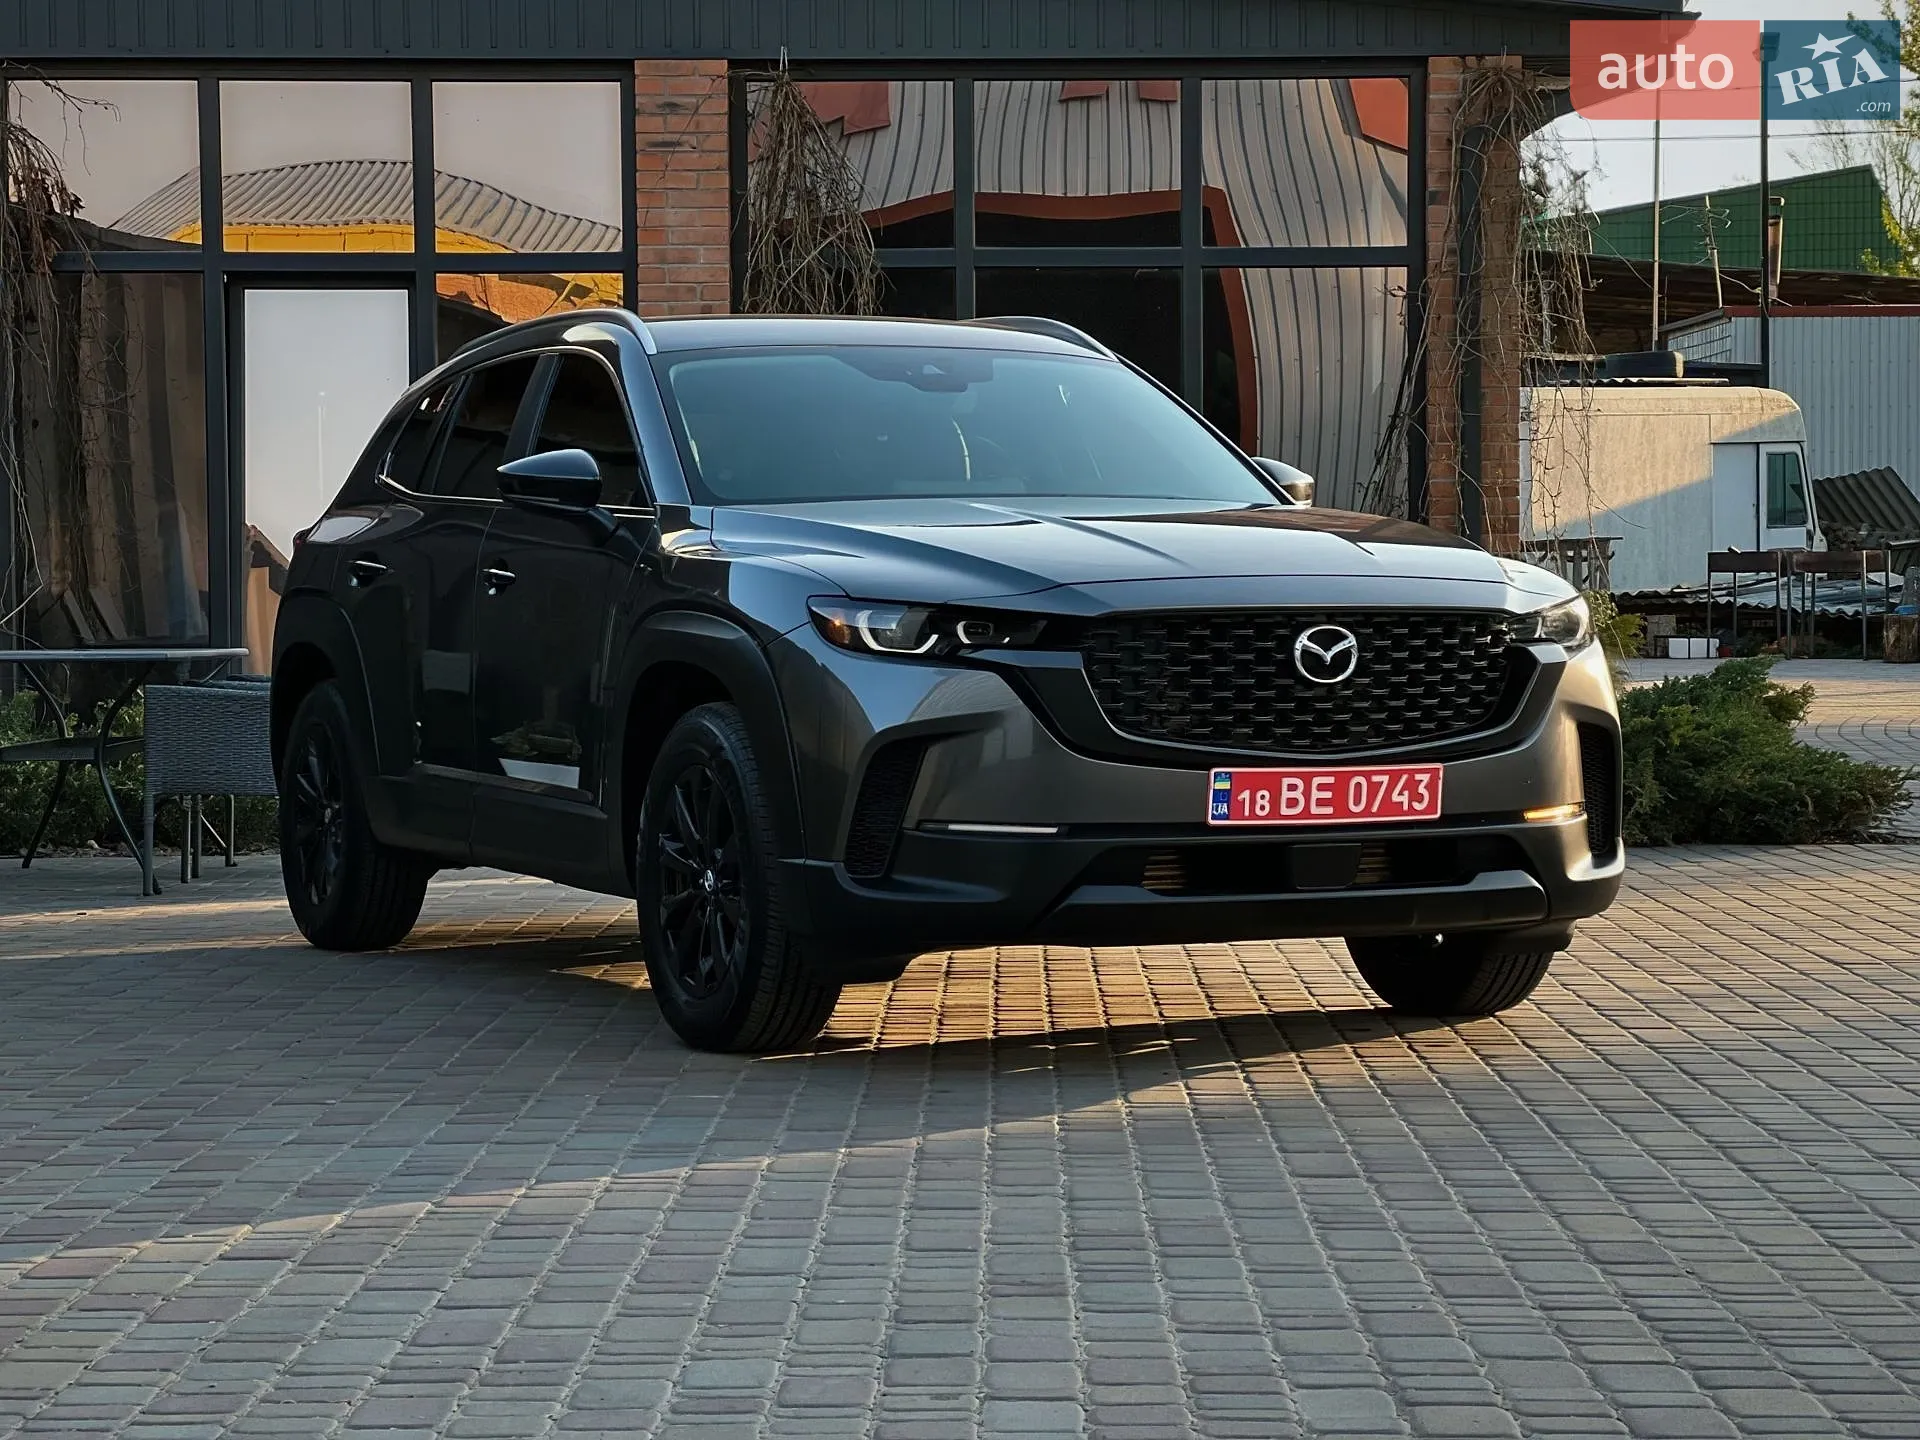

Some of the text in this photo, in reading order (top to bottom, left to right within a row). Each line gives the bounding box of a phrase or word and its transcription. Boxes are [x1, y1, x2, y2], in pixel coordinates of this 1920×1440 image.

[1212, 802, 1229, 816] UA
[1237, 773, 1432, 817] 18 BE 0743
